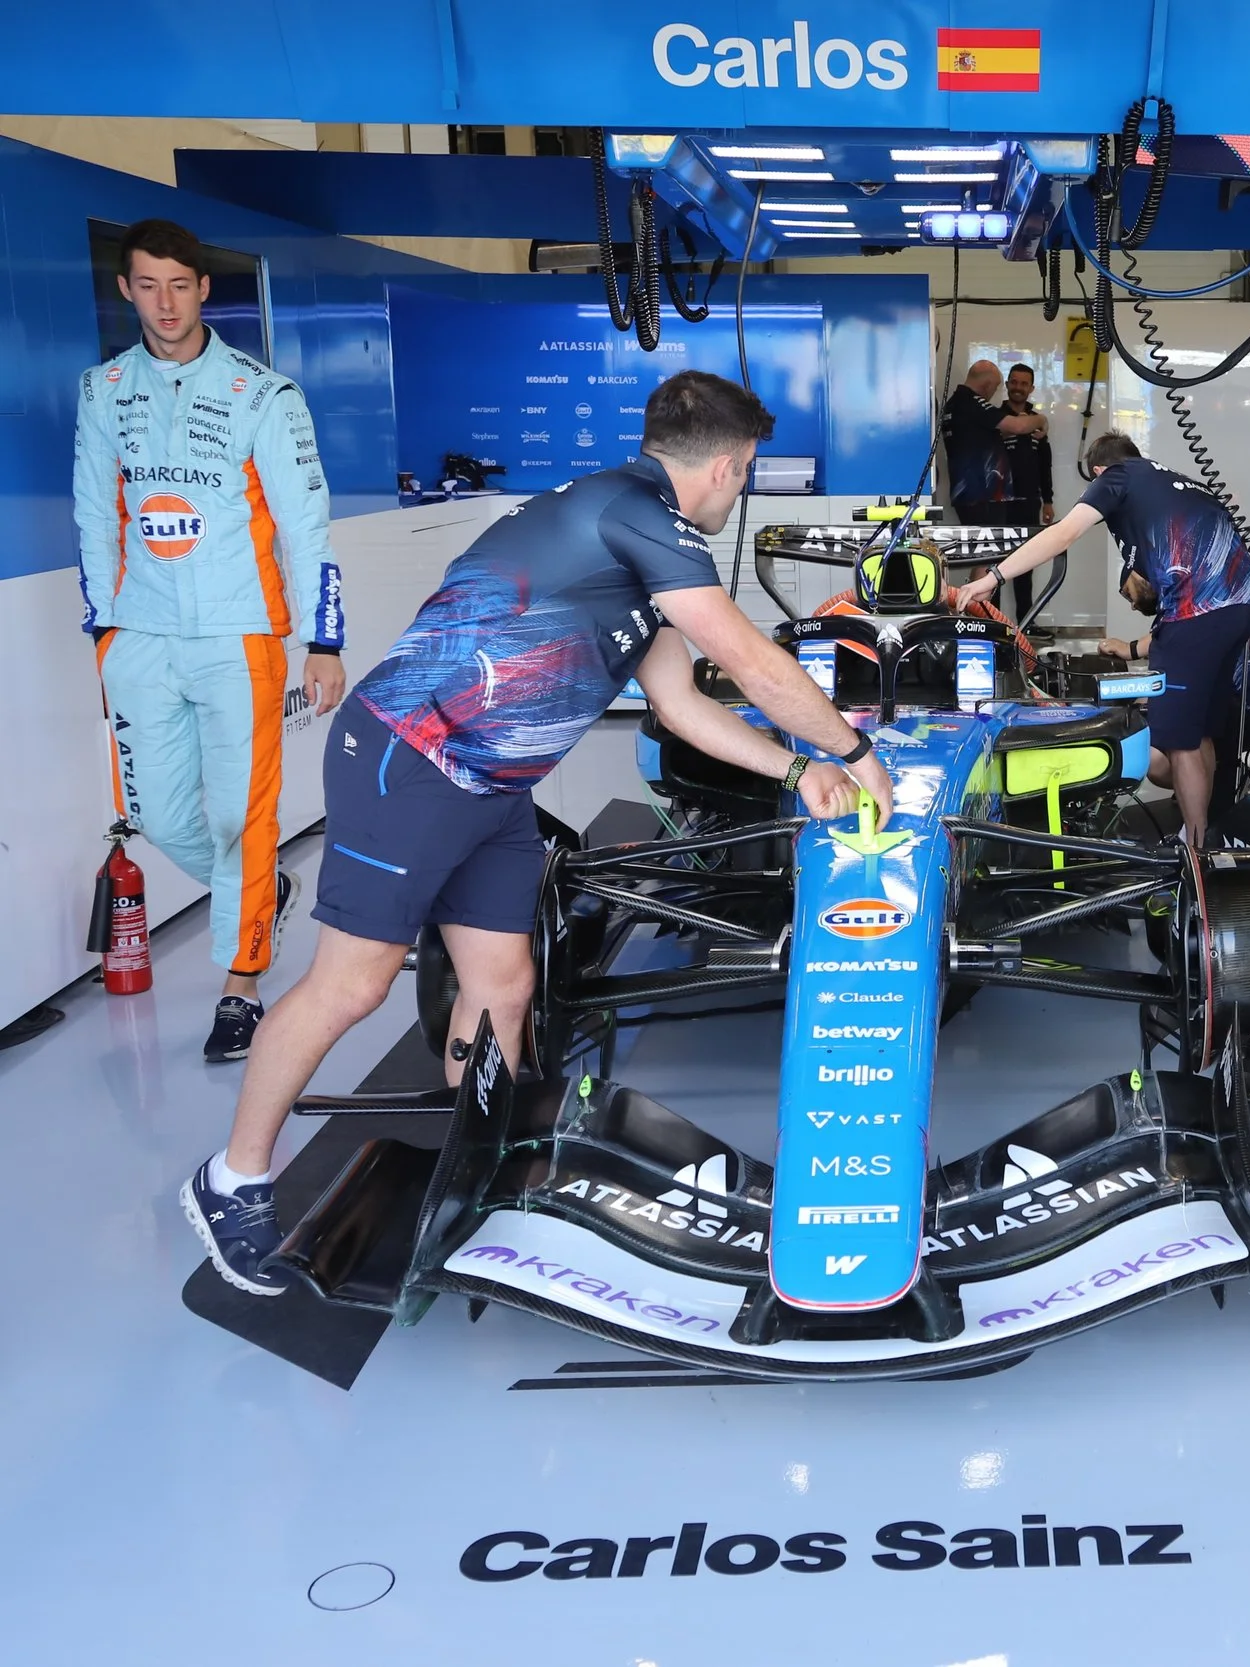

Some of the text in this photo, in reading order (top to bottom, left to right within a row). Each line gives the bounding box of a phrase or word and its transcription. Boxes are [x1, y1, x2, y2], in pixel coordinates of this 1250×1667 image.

[652, 20, 908, 90] Carlos
[551, 341, 613, 351] ATLASSIAN
[624, 340, 686, 352] Wams
[526, 374, 569, 384] KOMATSU
[597, 376, 638, 385] BARCLAYS
[619, 406, 646, 415] betway
[471, 432, 499, 440] Stephens
[134, 466, 222, 488] BARCLAYS
[140, 516, 202, 536] Gulf
[801, 621, 822, 633] airia
[966, 621, 986, 633] airia
[1111, 683, 1151, 694] BARCLAYS
[295, 714, 312, 732] TEAM
[824, 912, 905, 924] Gulf
[249, 920, 264, 961] sparco
[806, 958, 918, 972] KOMATSU
[838, 992, 904, 1003] Claude
[812, 1025, 903, 1041] betway
[818, 1065, 894, 1086] brillio
[838, 1113, 902, 1125] VAST
[810, 1155, 892, 1177] M&S
[798, 1204, 901, 1224] PIRELLI
[921, 1166, 1157, 1257] ATLASSIAN
[1031, 1234, 1236, 1312] kraken
[516, 1256, 721, 1333] kraken
[458, 1514, 1193, 1583] Carlos Sainz
